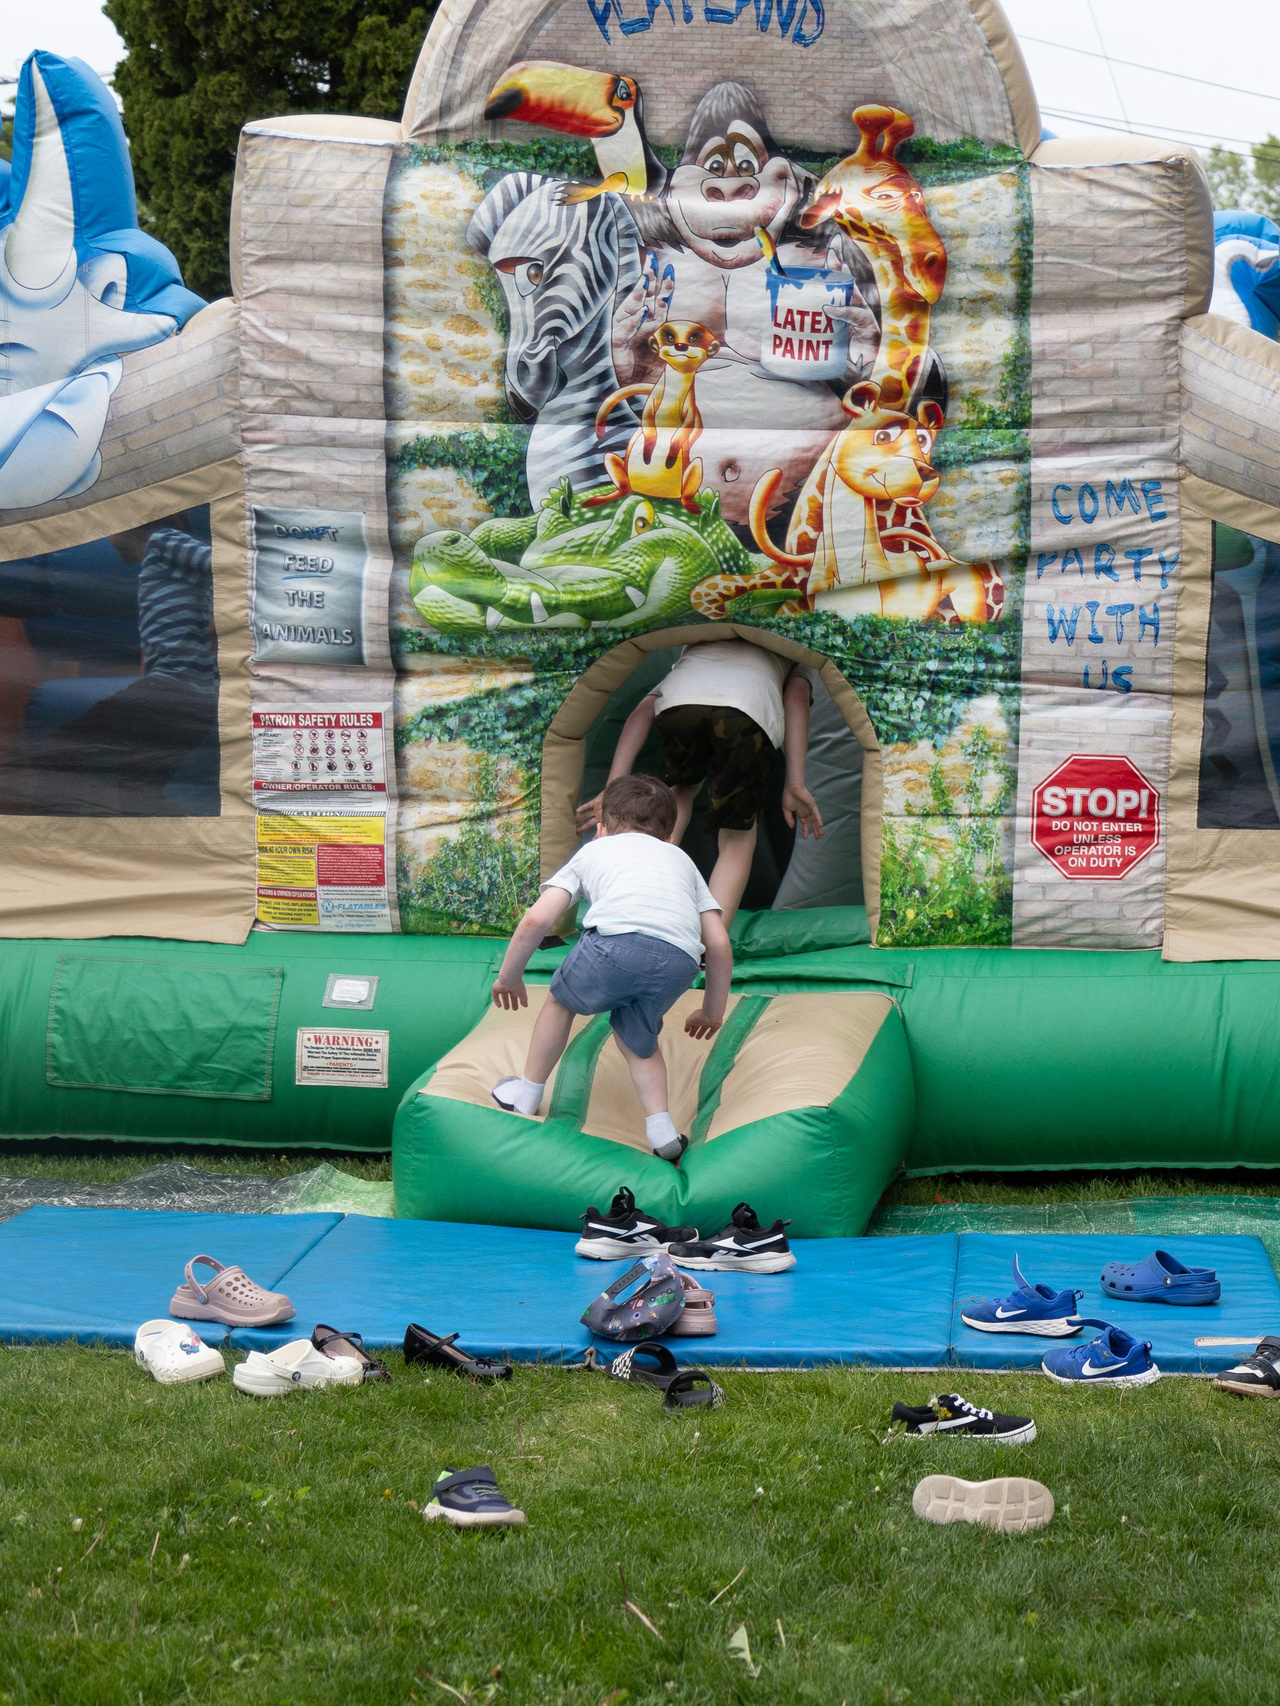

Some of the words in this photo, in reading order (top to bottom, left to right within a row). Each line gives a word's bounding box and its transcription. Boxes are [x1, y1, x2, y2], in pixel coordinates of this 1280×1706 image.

[773, 306, 834, 334] LATEX
[772, 334, 833, 361] PAINT
[1051, 477, 1167, 524] COME
[273, 524, 338, 542] DONT
[283, 554, 334, 573] FEED
[1037, 543, 1180, 589] PARTY
[285, 589, 325, 608] THE
[1046, 600, 1160, 647] WITH
[262, 623, 355, 645] ANIMALS
[1083, 660, 1133, 694] US
[260, 714, 296, 726] PATRON
[299, 714, 336, 727] SAFETY
[340, 714, 374, 727] RULES
[262, 782, 341, 791] OWNER/OPERATOR
[344, 783, 376, 791] RULES:
[1042, 786, 1149, 818] STOP!
[1052, 820, 1070, 831] DO
[1073, 821, 1099, 832] NOT
[1102, 822, 1142, 832] ENTER
[1073, 834, 1121, 844] UNLESS
[275, 846, 288, 854] YOUR
[289, 846, 301, 854] OWN
[1054, 845, 1121, 856] OPERATOR
[1124, 846, 1136, 856] IS
[1068, 857, 1086, 867] ON
[1090, 857, 1123, 868] DUTY
[313, 1034, 373, 1047] WARNING
